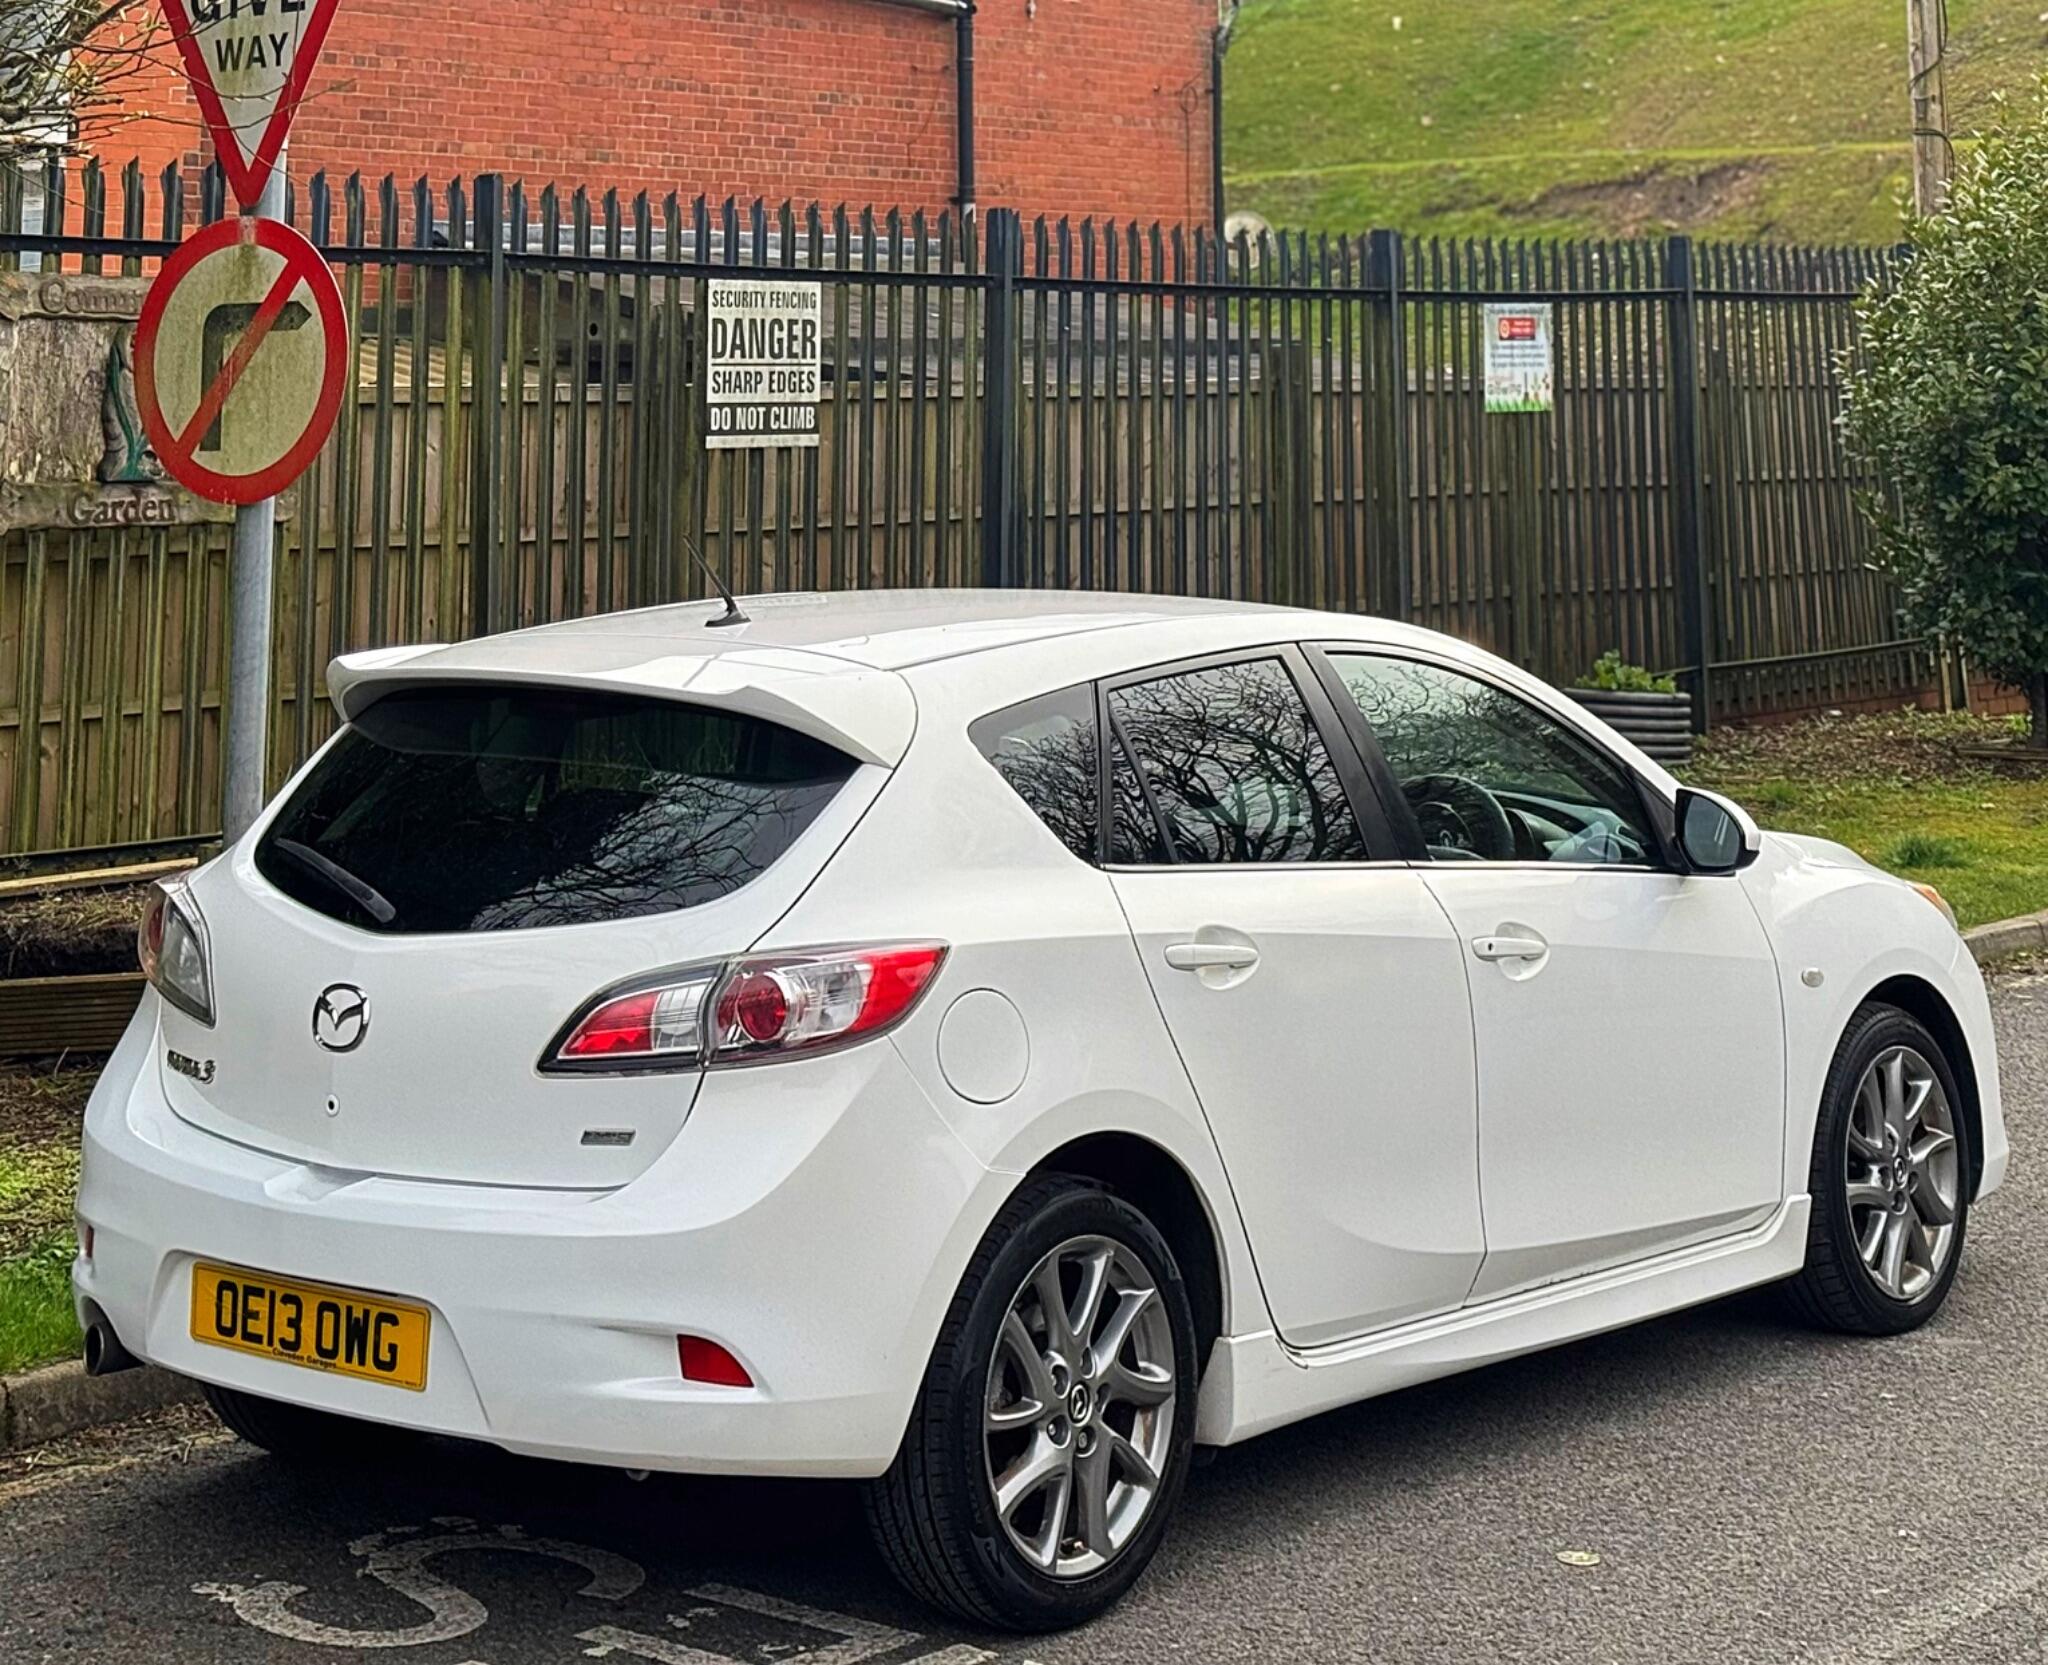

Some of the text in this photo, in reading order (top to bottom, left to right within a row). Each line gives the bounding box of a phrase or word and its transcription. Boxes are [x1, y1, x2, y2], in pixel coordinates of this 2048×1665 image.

[215, 32, 288, 72] WAY
[712, 290, 817, 309] SECURITY FENCING
[711, 317, 816, 360] DANGER
[711, 370, 815, 394] SHARP EDGES
[710, 406, 815, 431] DO NOT CLIMB
[66, 494, 179, 524] Garden
[215, 1279, 400, 1373] OE13 OWG
